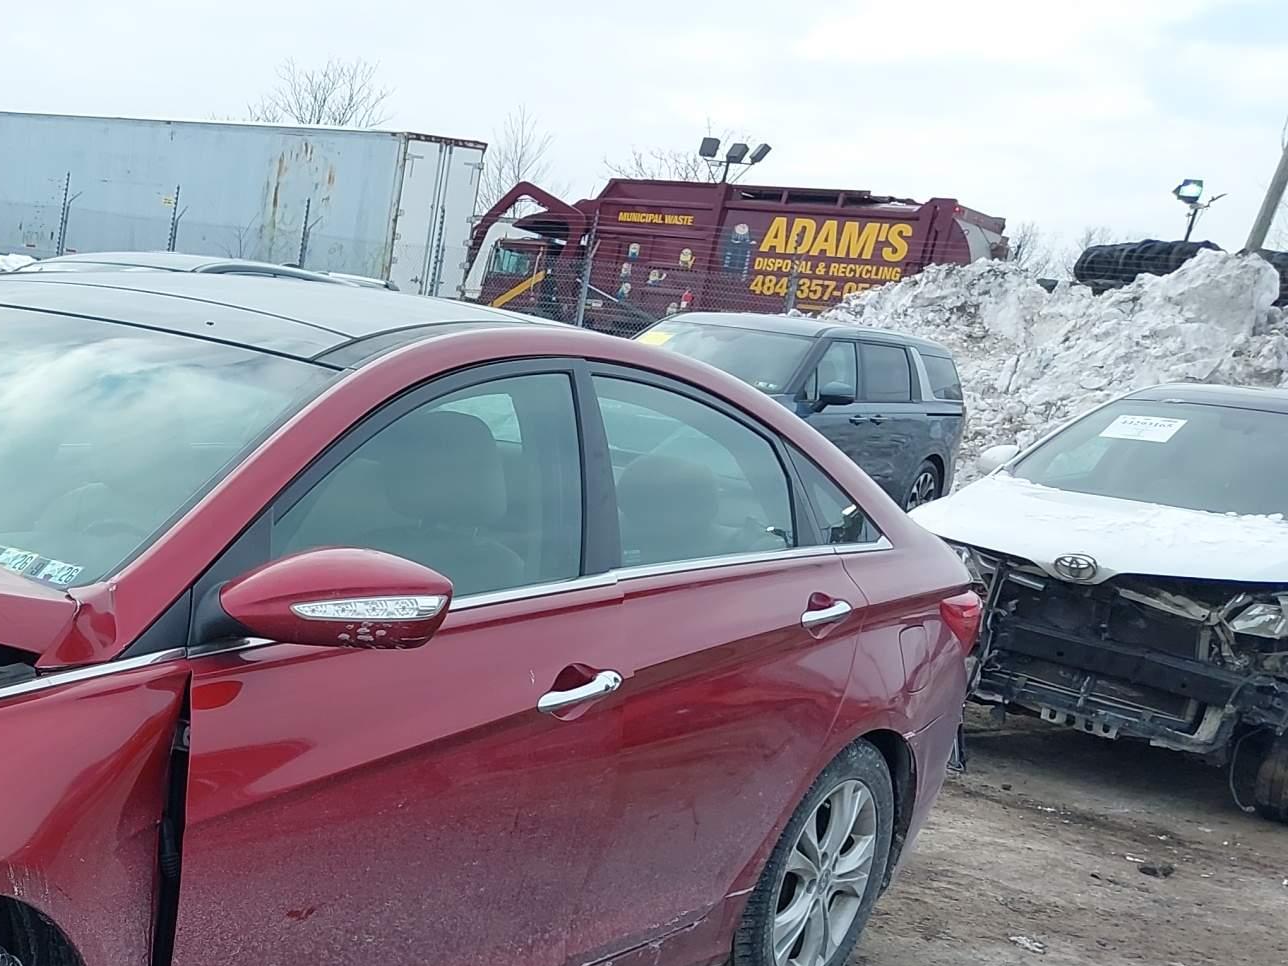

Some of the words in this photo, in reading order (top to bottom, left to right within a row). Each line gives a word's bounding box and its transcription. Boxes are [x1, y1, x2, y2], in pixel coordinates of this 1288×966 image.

[618, 211, 664, 224] MUNICIPAL
[664, 214, 694, 226] WASTE
[759, 216, 913, 262] ADAM'S
[815, 261, 827, 274] &
[829, 263, 902, 281] RECYCLING
[12, 554, 33, 571] 26
[58, 566, 80, 583] 26
